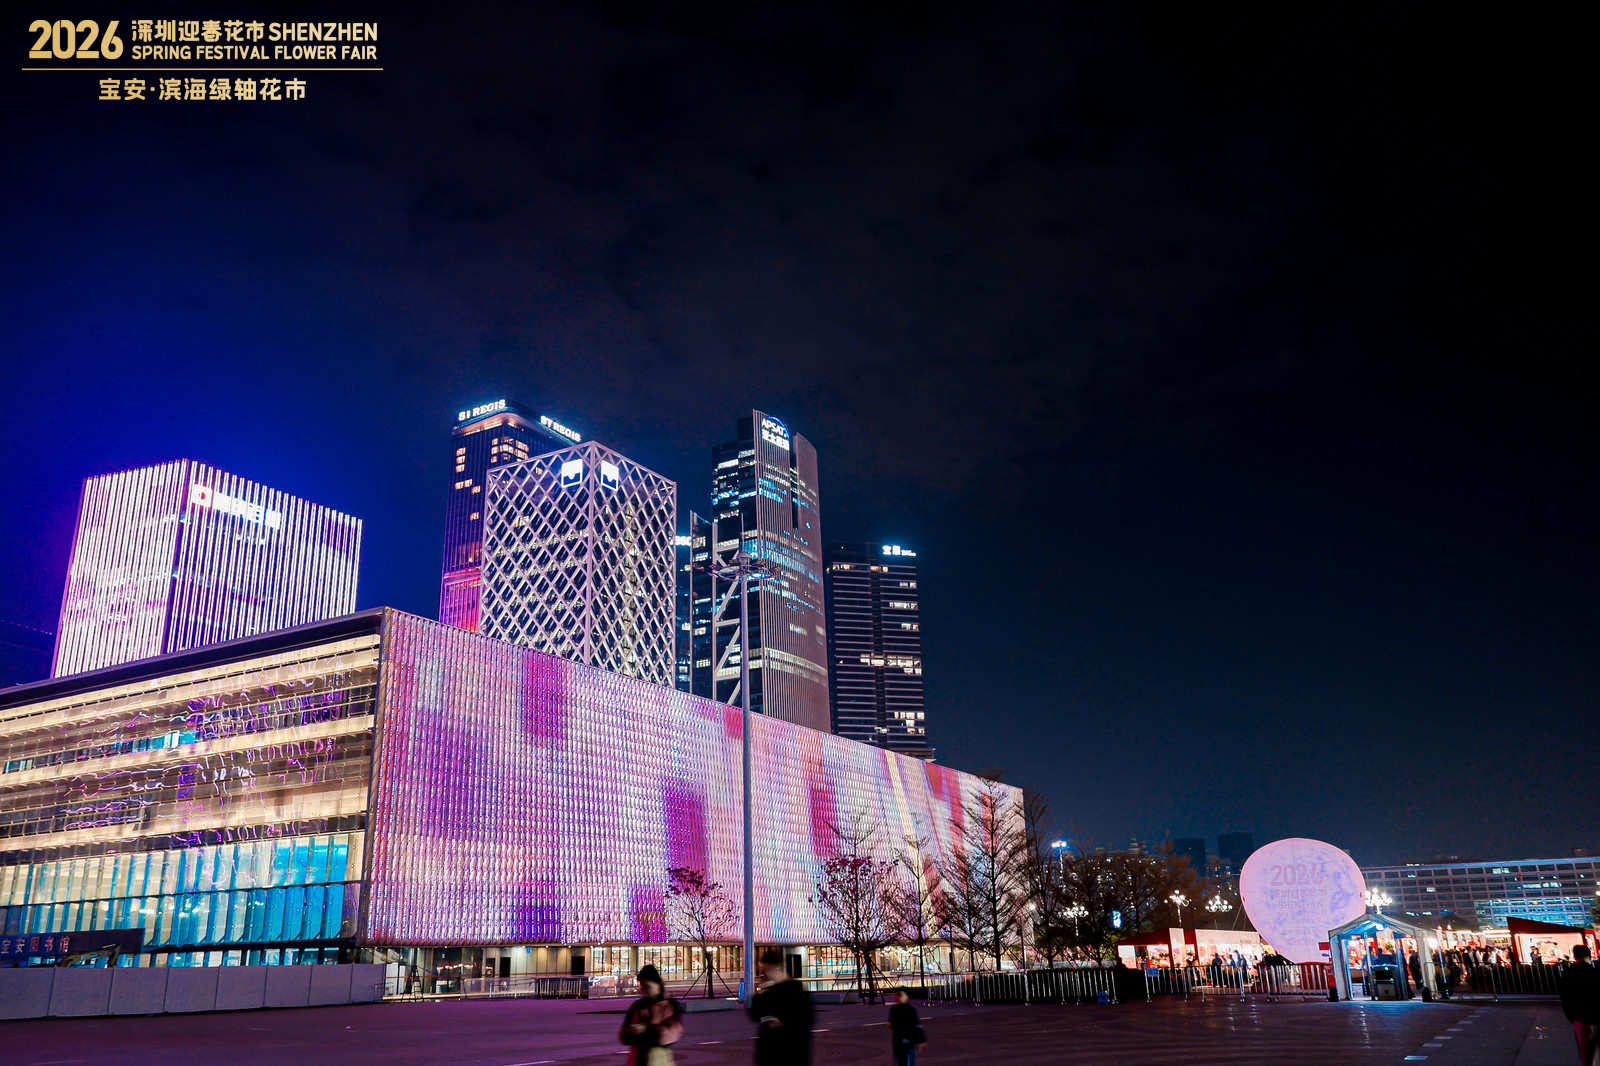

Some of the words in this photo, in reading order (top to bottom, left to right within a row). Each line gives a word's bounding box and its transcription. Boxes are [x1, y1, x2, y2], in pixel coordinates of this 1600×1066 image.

[472, 399, 506, 417] REGIS
[553, 421, 581, 442] REGIS
[1270, 864, 1324, 886] 2026
[1278, 900, 1324, 910] SHENZHEN
